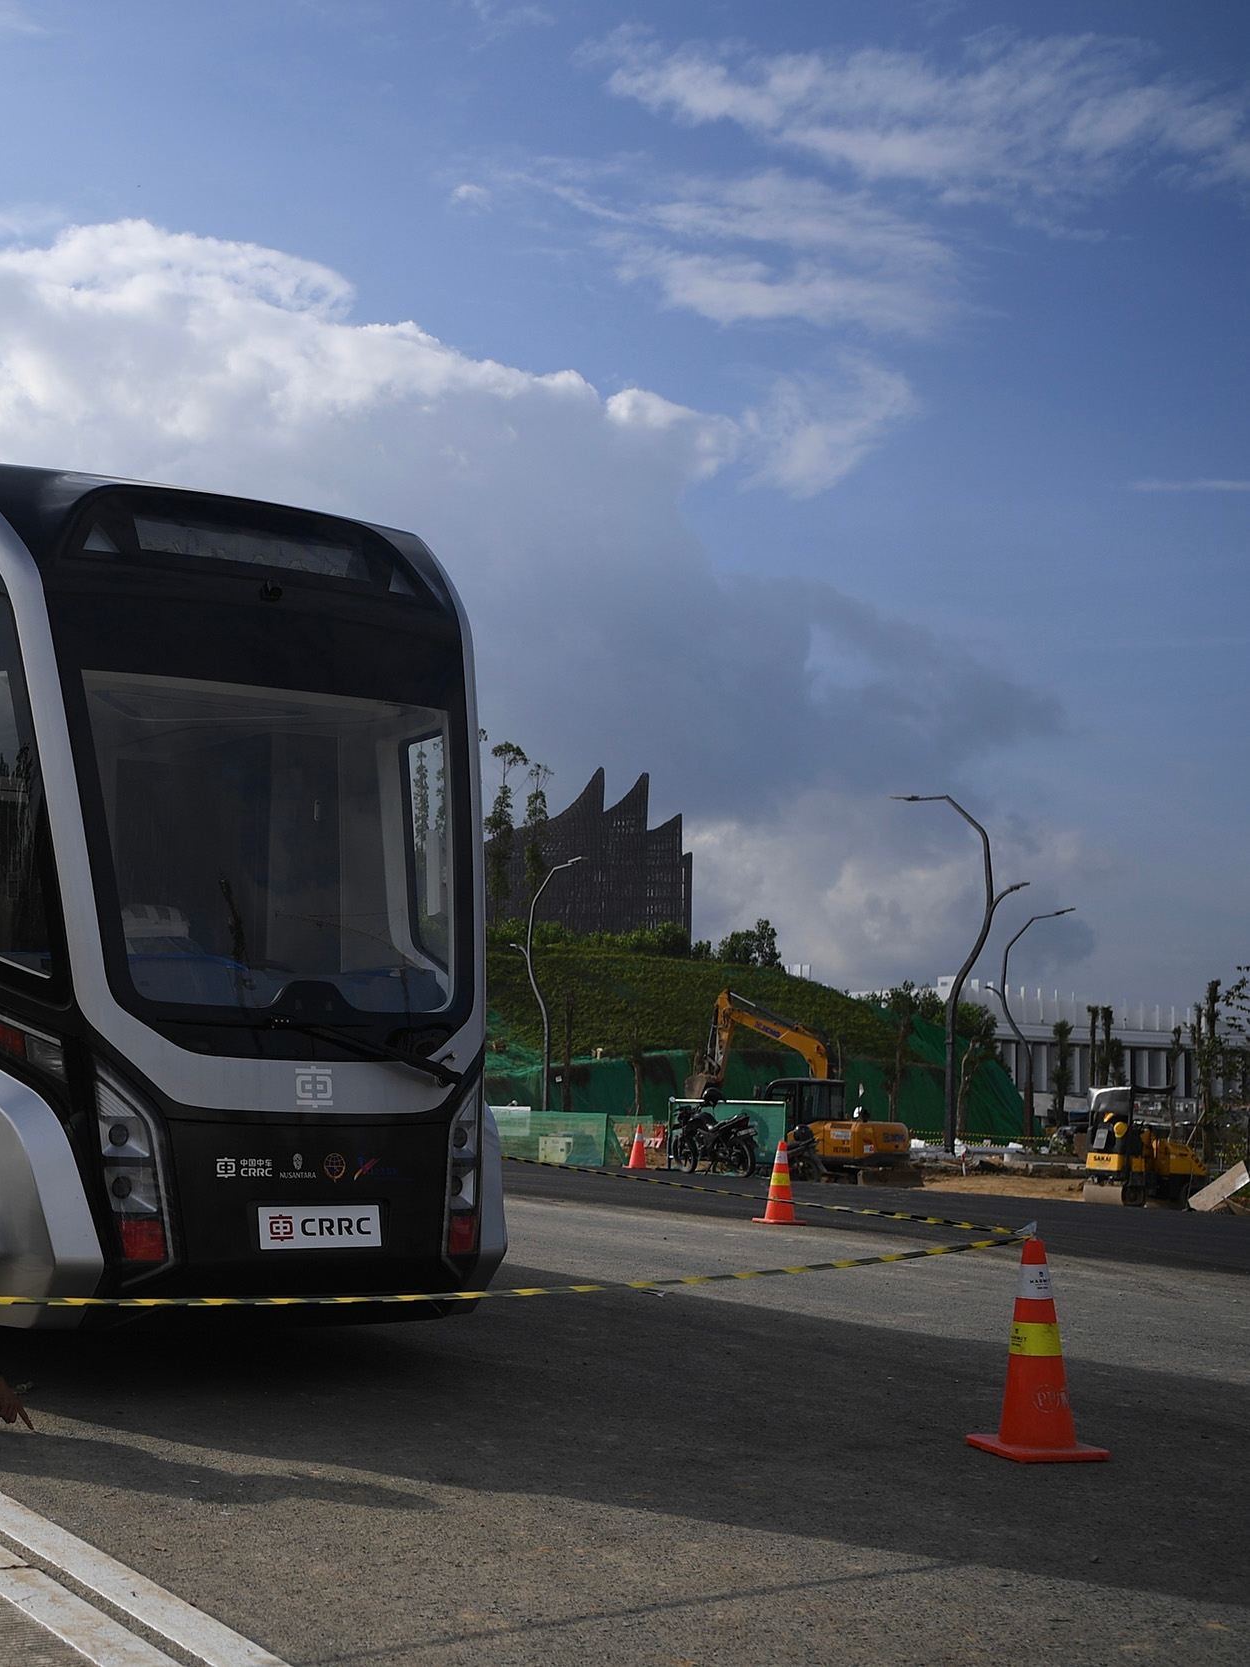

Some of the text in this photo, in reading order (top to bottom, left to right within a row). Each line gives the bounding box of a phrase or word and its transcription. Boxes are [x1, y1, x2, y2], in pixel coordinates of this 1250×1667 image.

[240, 1158, 272, 1167] 中国中车
[240, 1167, 273, 1177] CRRC
[279, 1171, 317, 1179] NUSANTARA
[301, 1217, 371, 1236] CRRC
